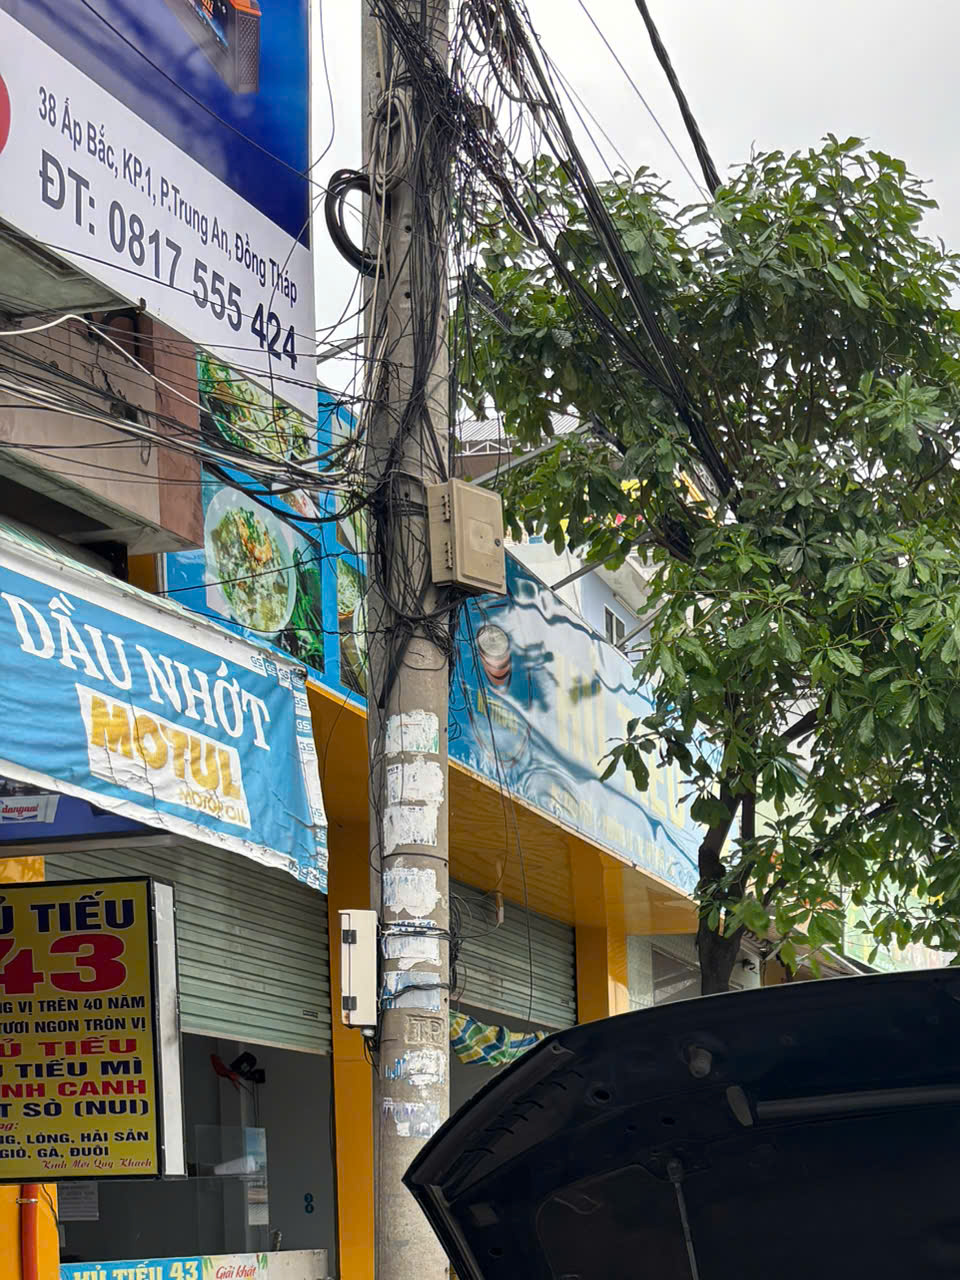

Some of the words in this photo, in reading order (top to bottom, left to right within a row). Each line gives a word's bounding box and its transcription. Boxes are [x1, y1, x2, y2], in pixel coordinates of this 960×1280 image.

[38, 86, 57, 129] 38
[61, 97, 82, 149] Ấp
[87, 121, 118, 178] Bắc,
[123, 148, 157, 205] KP.1,
[160, 177, 208, 244] P.Trung
[211, 220, 233, 260] An,
[235, 233, 267, 289] Đồng
[269, 258, 298, 307] Tháp
[39, 149, 96, 237] ĐT:
[109, 200, 182, 288] 0817
[193, 257, 242, 332] 555
[251, 303, 298, 370] 424
[1, 592, 132, 690] DẦU
[136, 644, 270, 751] NHỚT
[91, 694, 240, 799] MOTUL
[30, 891, 134, 932] TIẾU
[0, 933, 127, 994] 43
[18, 1001, 32, 1016] VỊ
[38, 997, 78, 1012] TRÊN
[84, 998, 102, 1010] 40
[108, 995, 145, 1009] NĂM
[35, 1020, 79, 1032] NGON
[84, 1016, 125, 1031] TRÒN
[131, 1017, 146, 1031] VỊ
[38, 1035, 136, 1056] TIẾU
[15, 1058, 87, 1078] TIẾU
[101, 1057, 142, 1075] MÌ
[57, 1080, 146, 1096] CANH
[23, 1098, 62, 1117] SÒ
[75, 1100, 148, 1117] (NUI)
[80, 1129, 108, 1142] HẢI
[114, 1128, 148, 1141] SẢN
